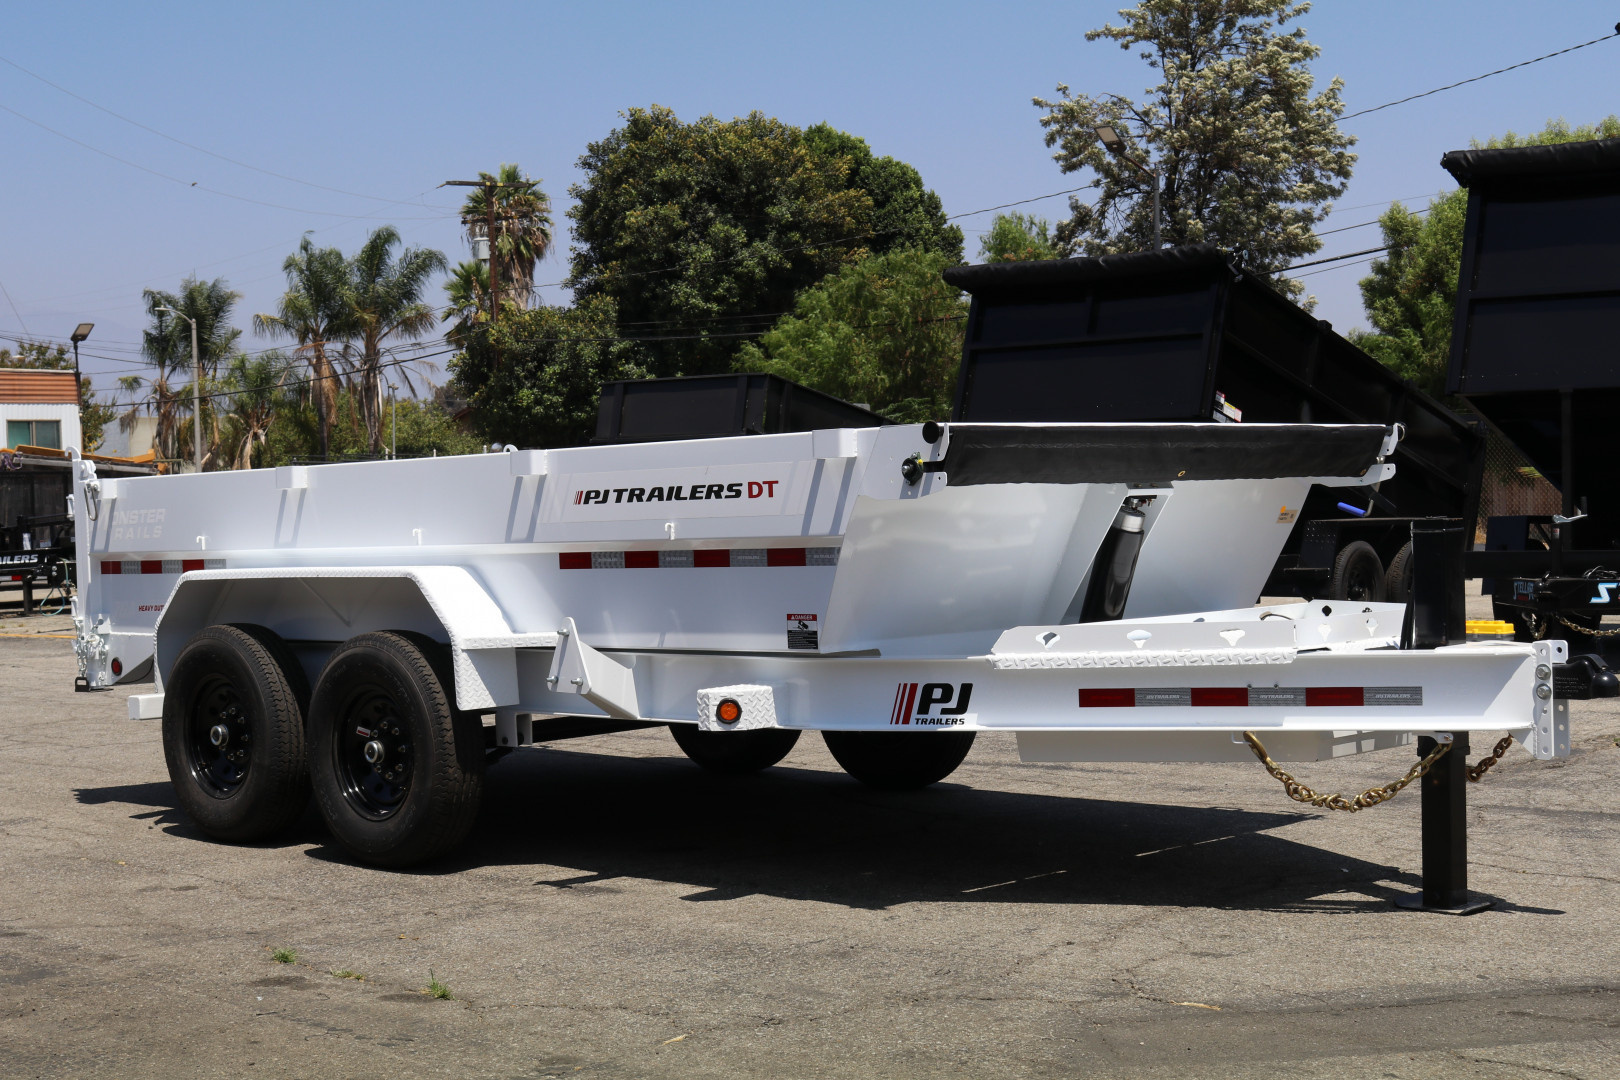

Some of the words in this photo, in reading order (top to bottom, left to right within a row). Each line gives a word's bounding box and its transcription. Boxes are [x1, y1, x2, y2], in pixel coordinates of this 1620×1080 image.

[747, 480, 779, 499] DT
[115, 525, 163, 541] RAILS
[0, 554, 39, 565] ILERS
[153, 604, 165, 612] DUT
[917, 683, 973, 715] PJ
